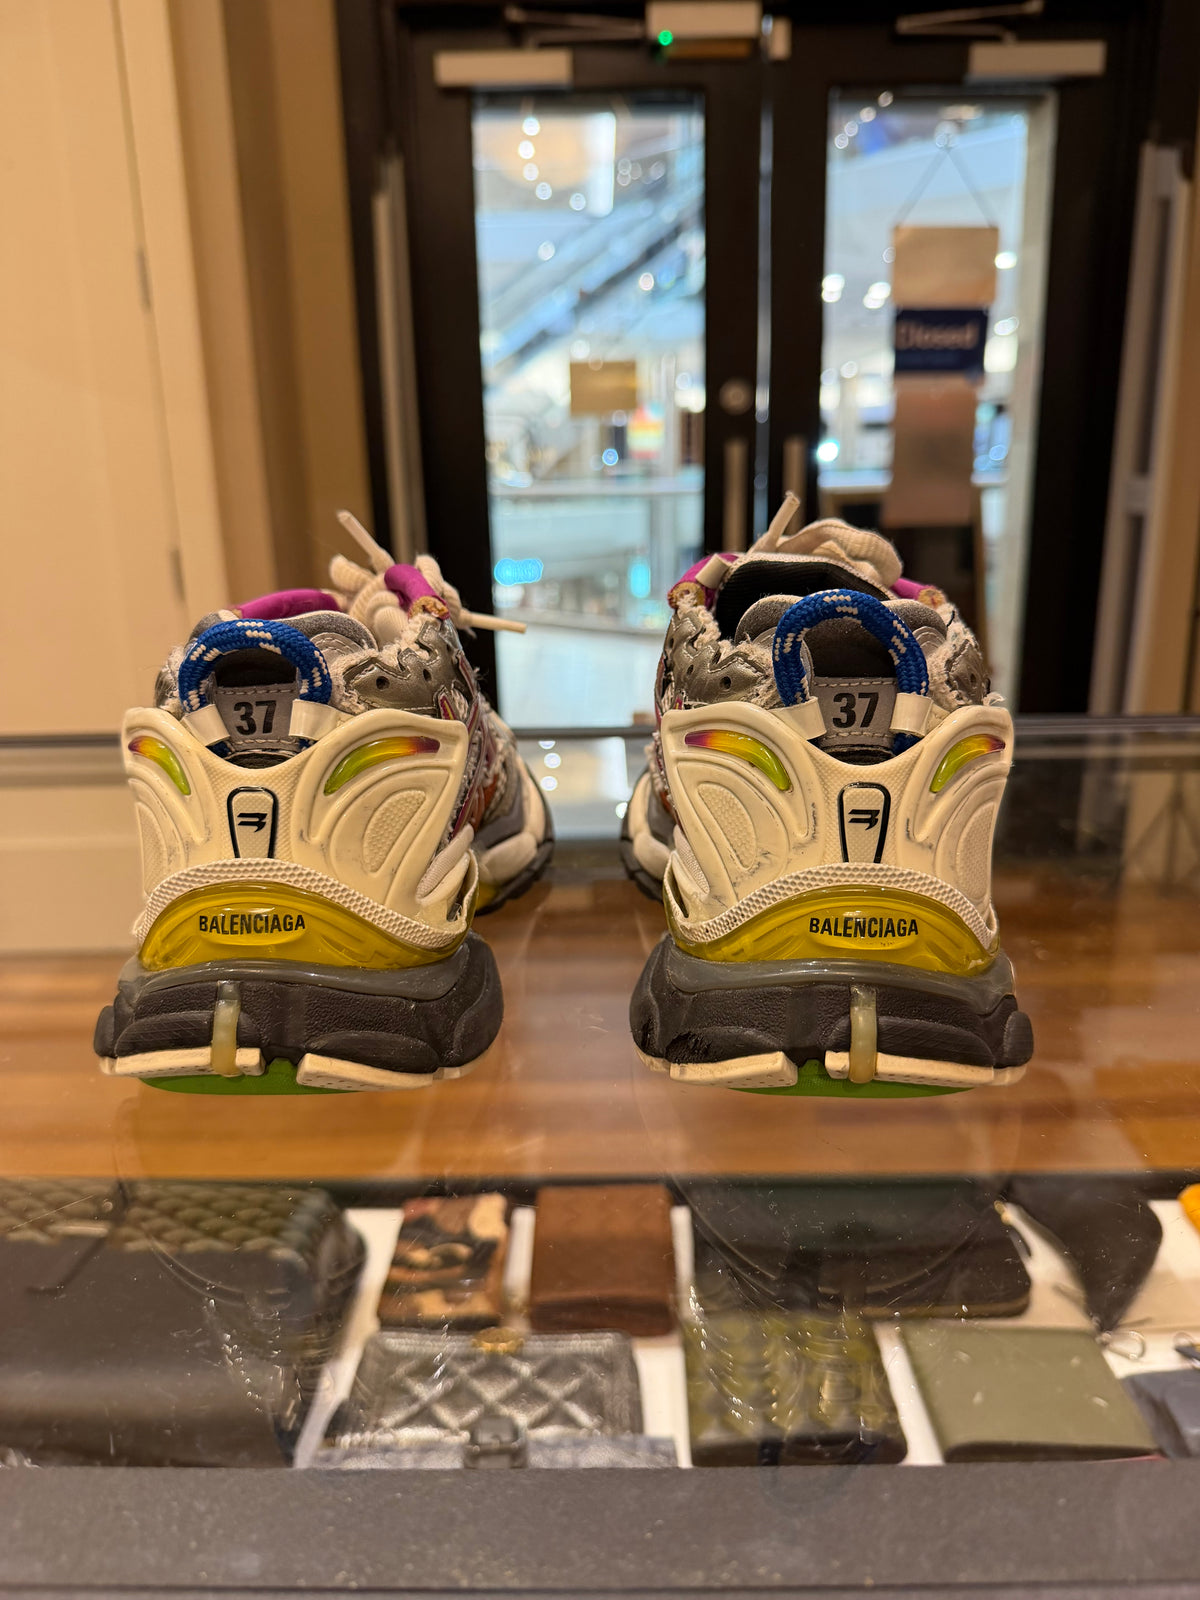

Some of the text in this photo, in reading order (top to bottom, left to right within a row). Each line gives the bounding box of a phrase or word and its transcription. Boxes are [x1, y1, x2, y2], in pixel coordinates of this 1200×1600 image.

[897, 321, 977, 349] Closed
[233, 700, 277, 735] 37
[832, 692, 879, 728] 37
[199, 914, 306, 935] BALENCIAGA
[809, 917, 919, 938] BALENCIAGA
